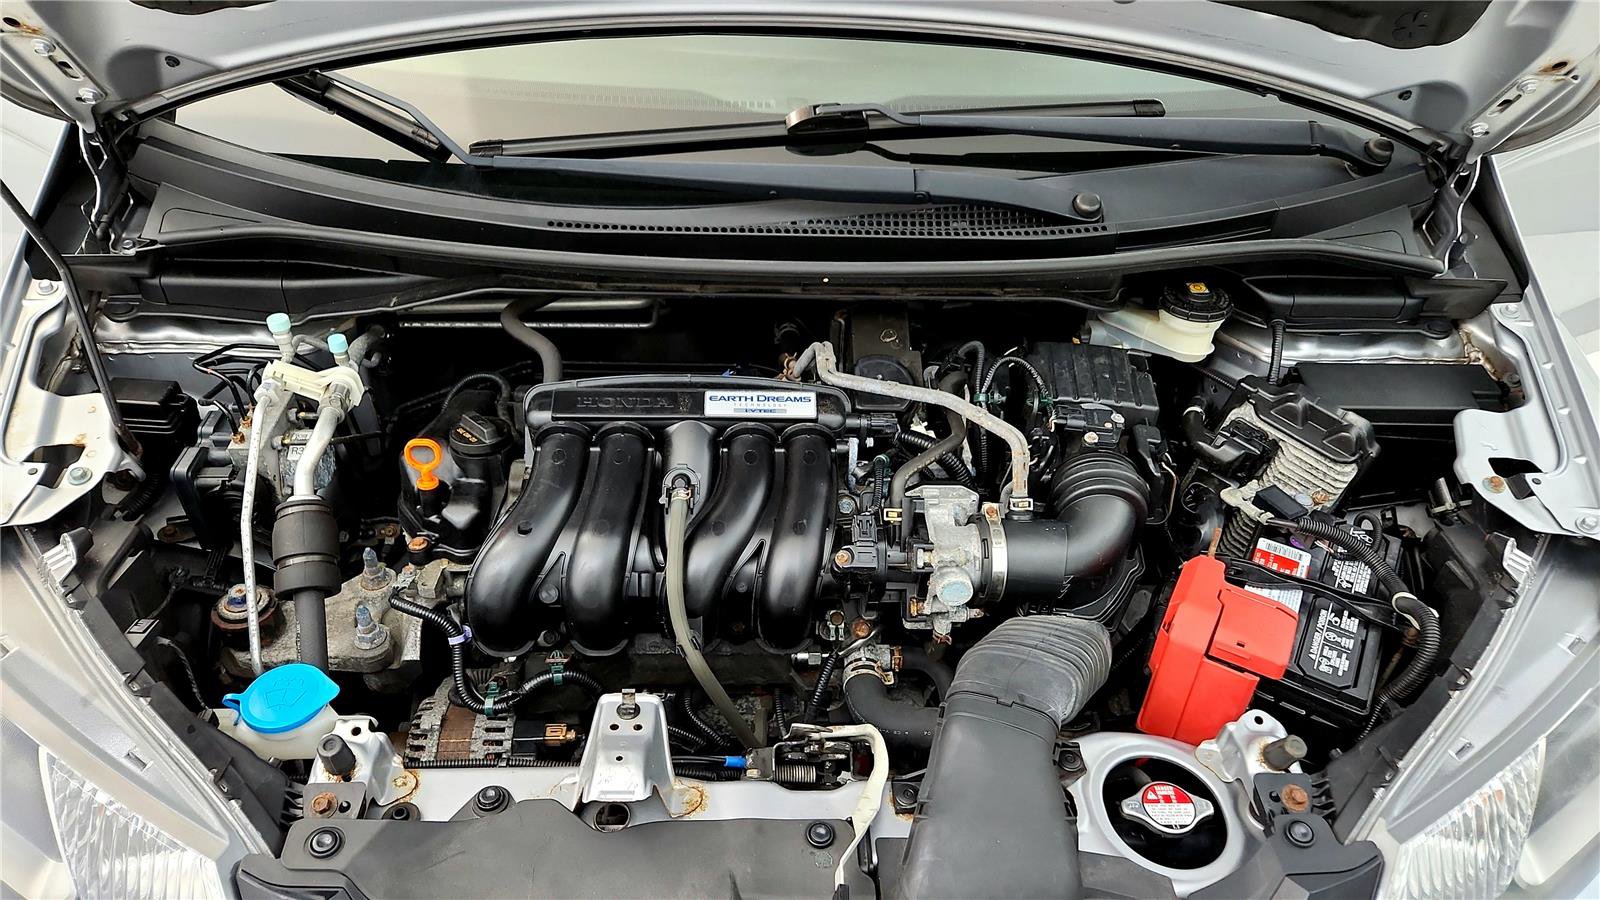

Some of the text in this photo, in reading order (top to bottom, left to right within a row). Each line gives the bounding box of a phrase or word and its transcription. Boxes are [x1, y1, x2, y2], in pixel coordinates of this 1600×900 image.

[577, 397, 674, 408] HONDA
[756, 394, 812, 403] DREAMS
[1310, 631, 1322, 655] DANGER
[1316, 608, 1328, 629] POISON
